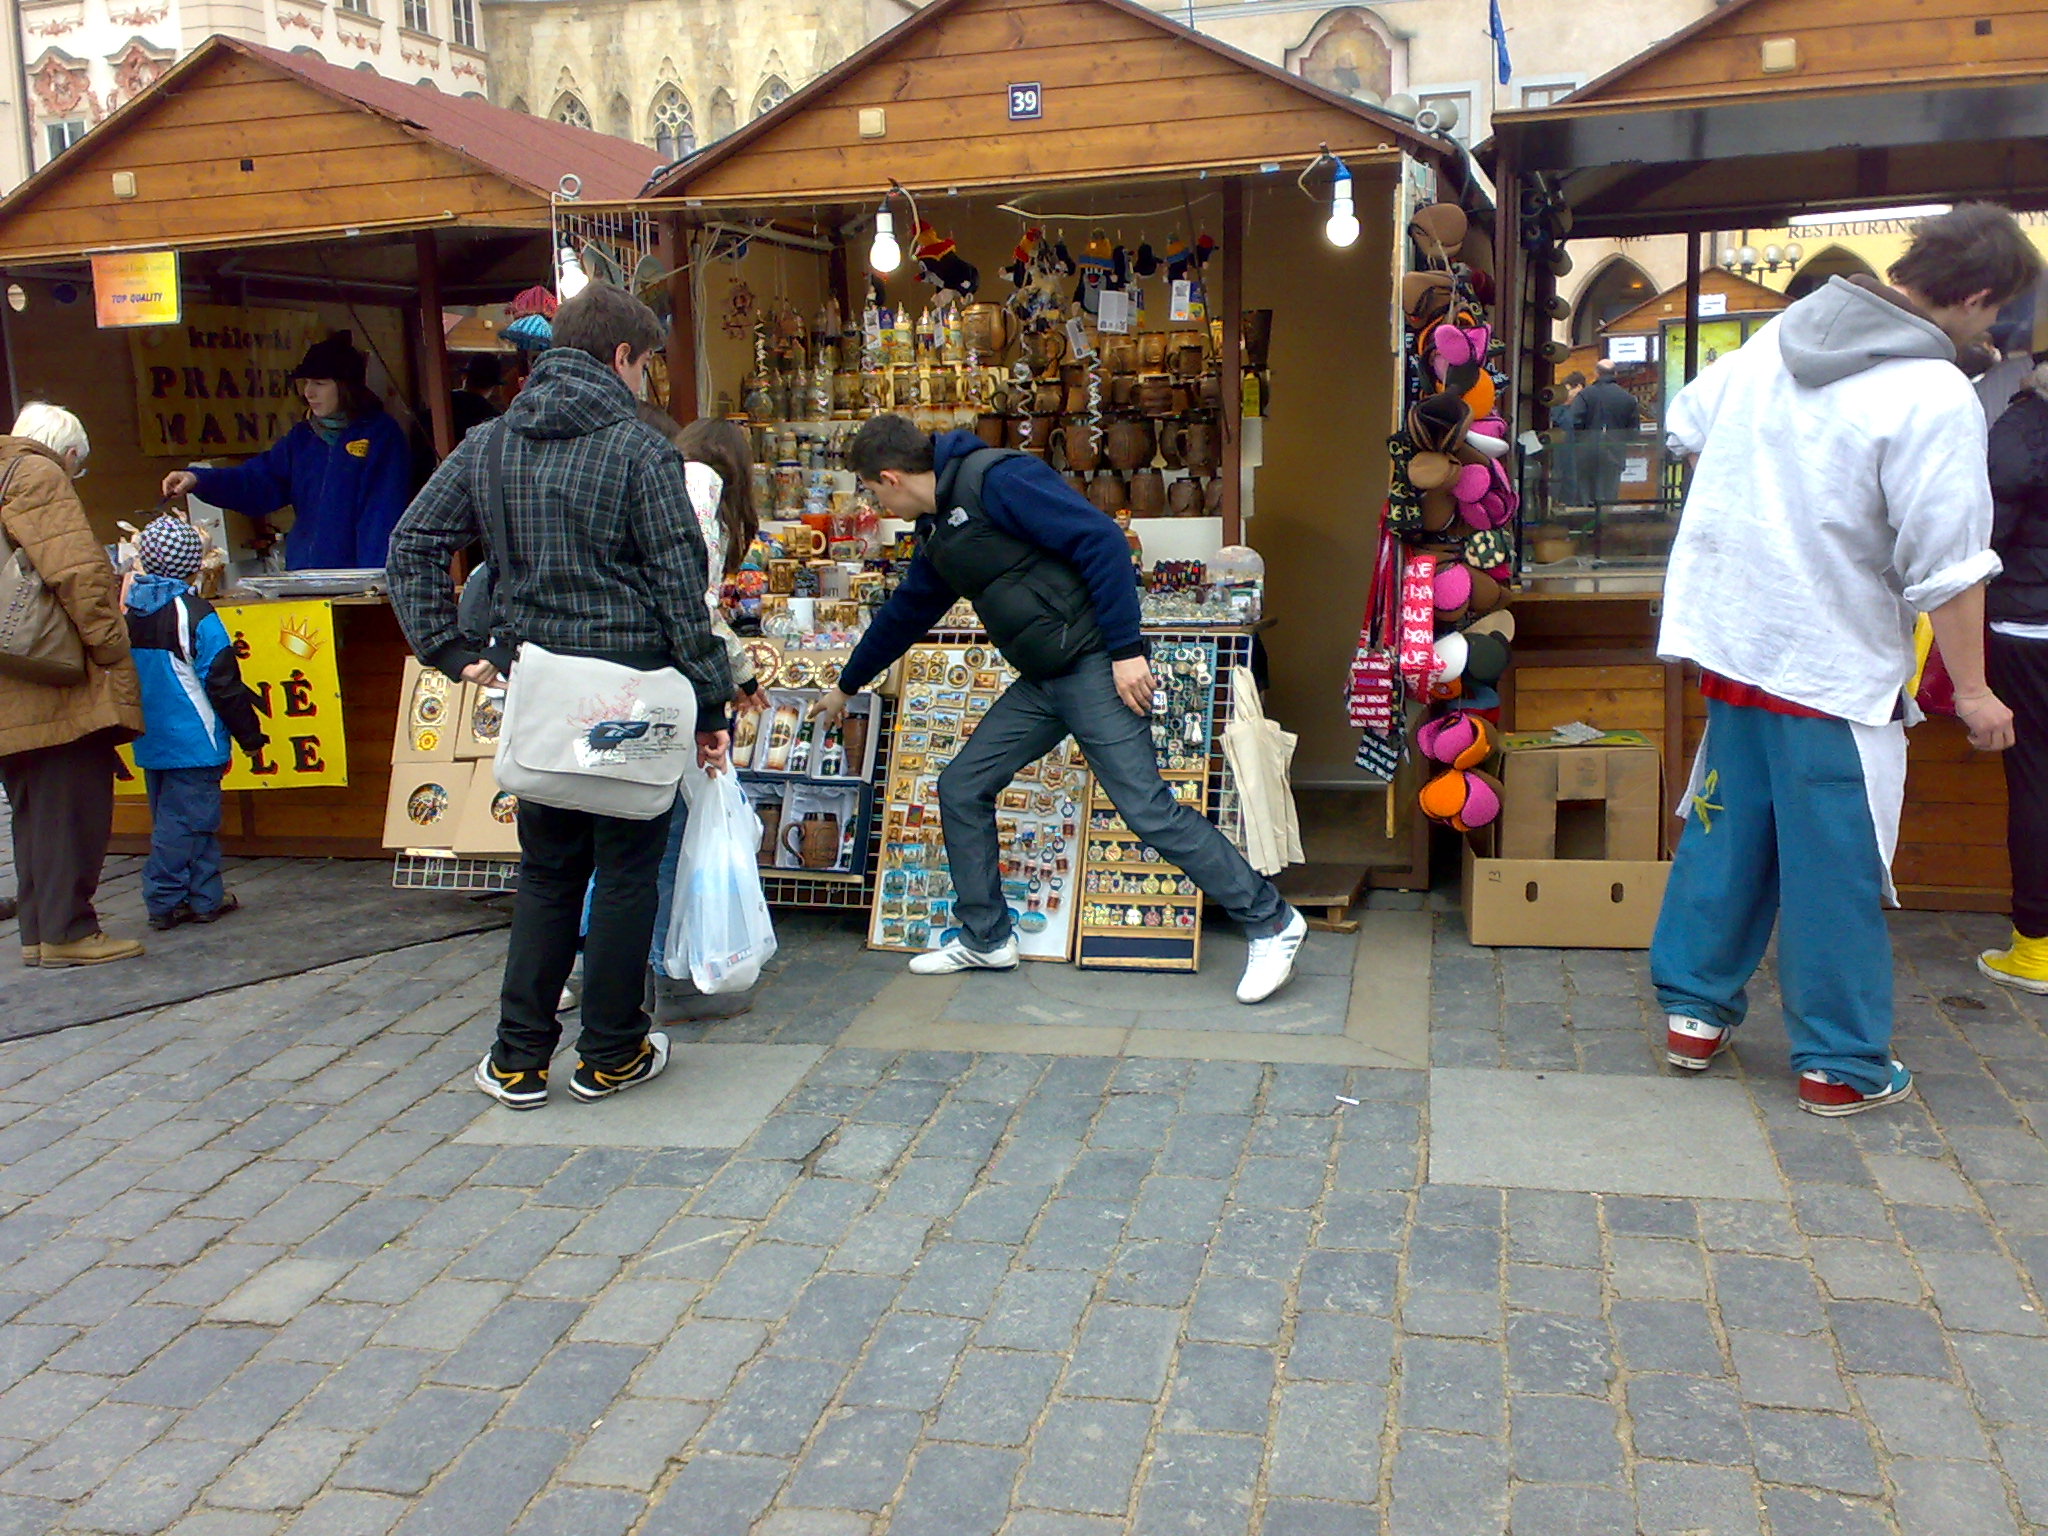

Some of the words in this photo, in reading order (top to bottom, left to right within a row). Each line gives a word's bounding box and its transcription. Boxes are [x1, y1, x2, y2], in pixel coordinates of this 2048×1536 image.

[1012, 91, 1037, 112] 39
[1789, 219, 1910, 239] RESTAURAN
[111, 294, 127, 304] TOP
[130, 292, 163, 303] QUALITY
